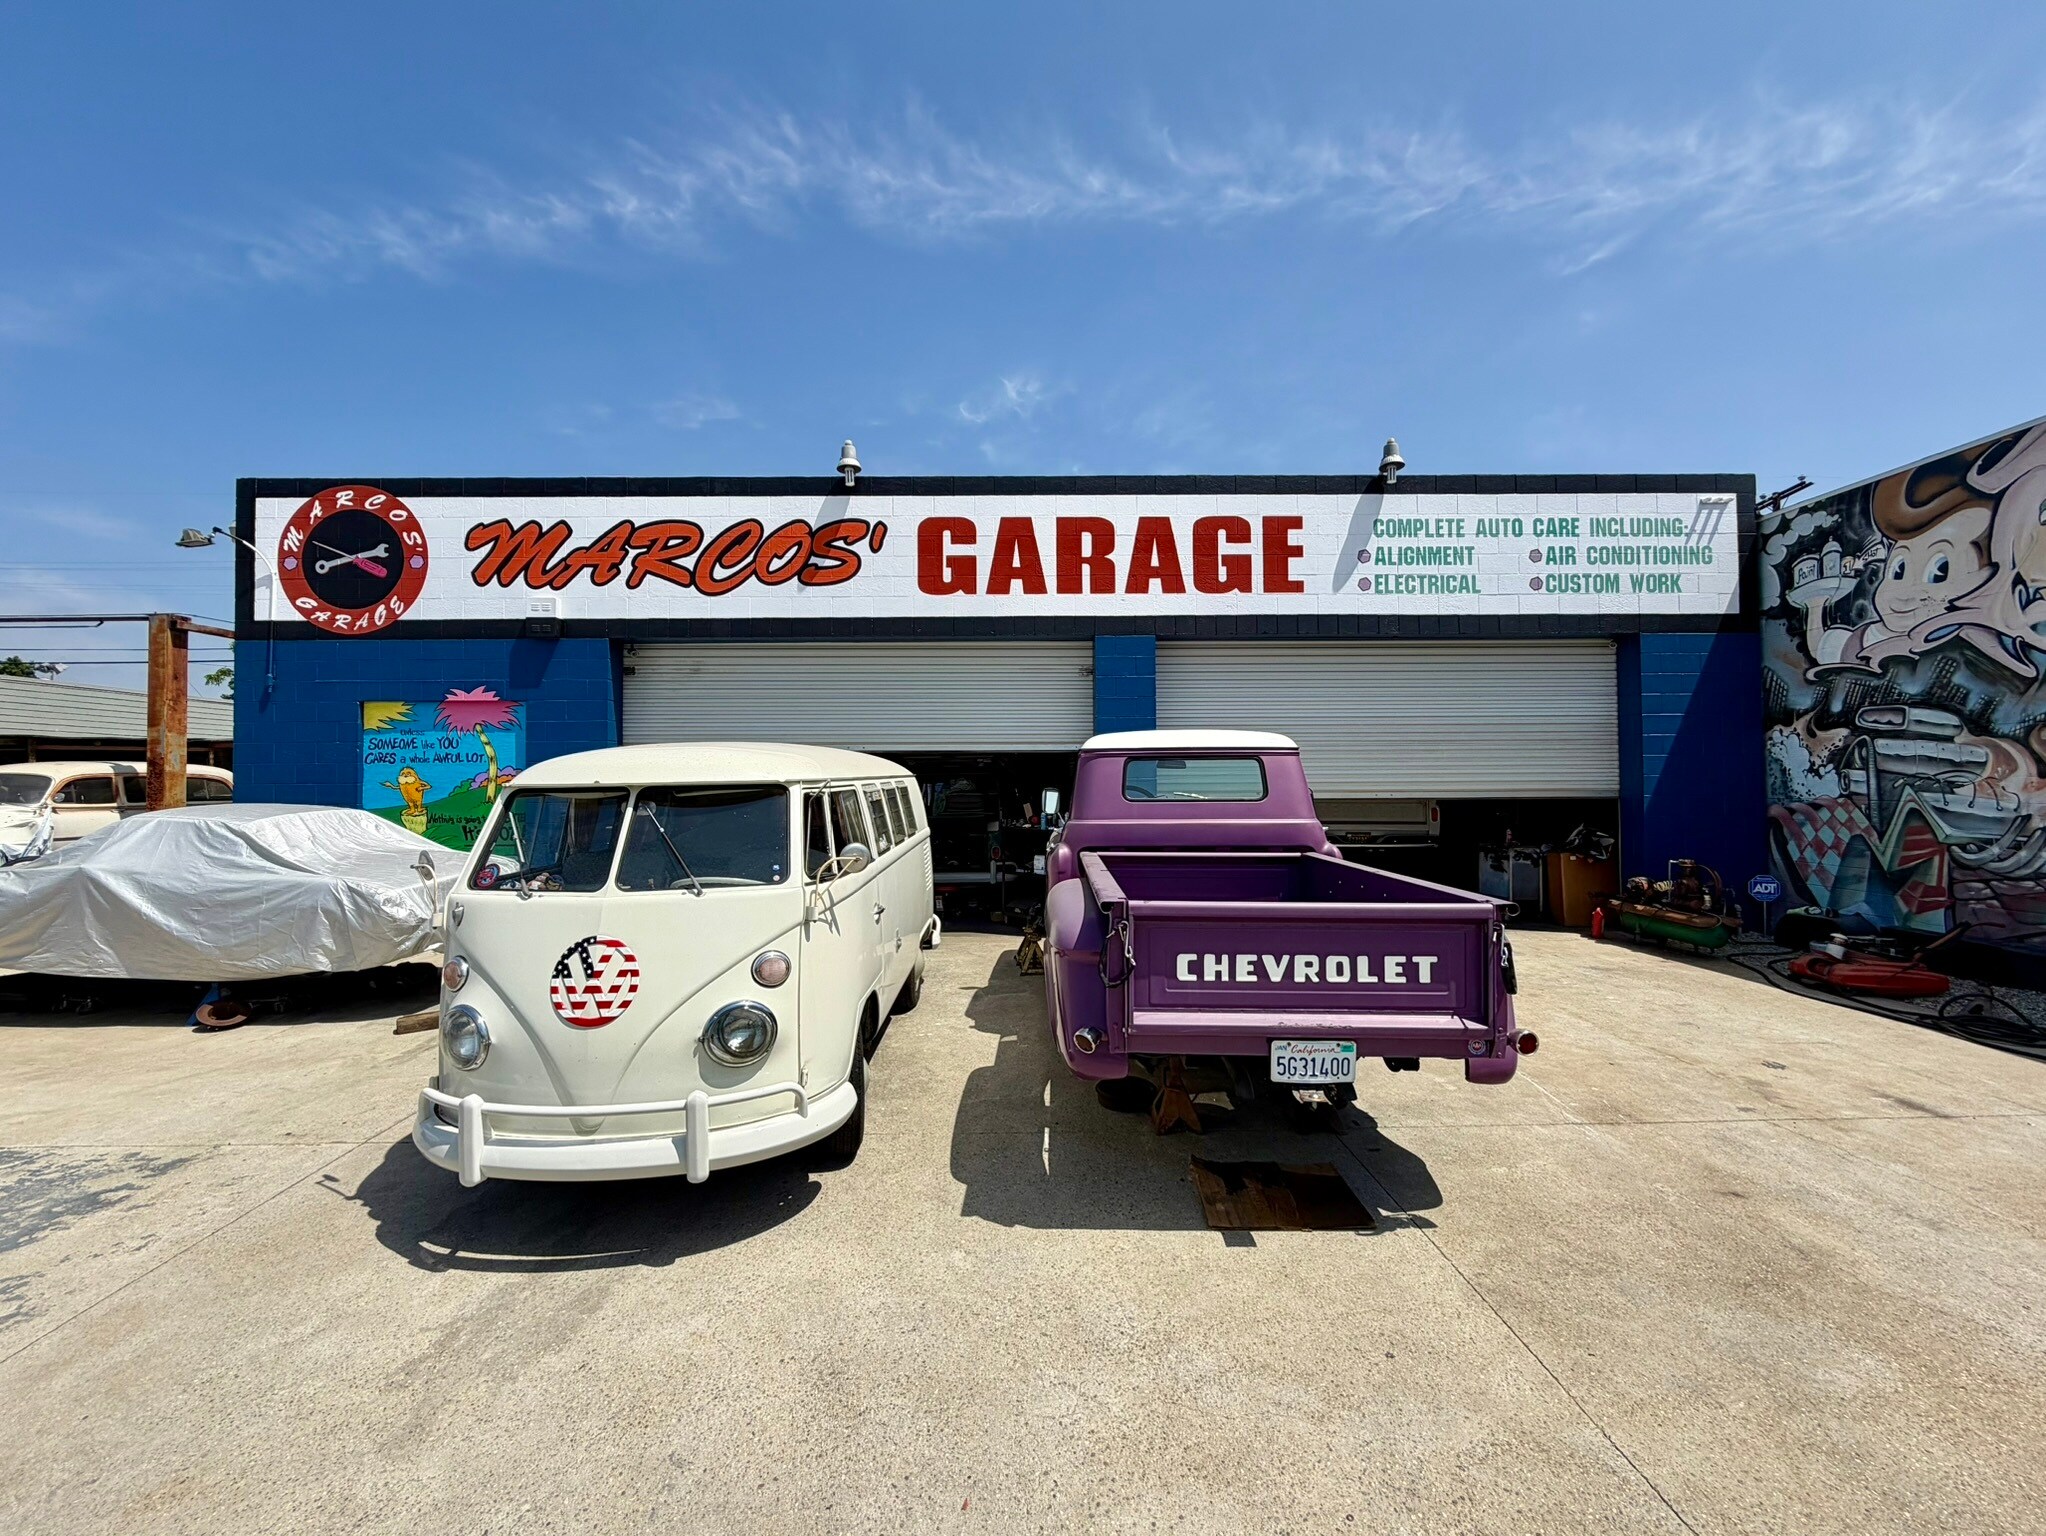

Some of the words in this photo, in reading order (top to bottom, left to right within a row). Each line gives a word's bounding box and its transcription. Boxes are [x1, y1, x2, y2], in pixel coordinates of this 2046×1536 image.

[283, 490, 423, 551] MARCOS'
[1373, 518, 1465, 538] COMPLETE
[1475, 518, 1524, 538] AUTO
[1533, 517, 1580, 537] CARE
[1589, 517, 1689, 537] INCLUDING:
[464, 518, 888, 596] MARCOS'
[917, 515, 1305, 595] GARAGE
[1374, 546, 1475, 566] ALIGNMENT
[1545, 546, 1576, 565] AIR
[1586, 545, 1713, 565] CONDITIONING
[1374, 574, 1481, 594] ELECTRICAL
[1545, 573, 1620, 593] CUSTOM
[1630, 573, 1682, 593] WORK
[295, 595, 404, 631] GARAGE
[368, 737, 418, 750] SOMEONE
[421, 739, 435, 749] like
[436, 736, 459, 749] YOU
[364, 752, 396, 764] CARES
[409, 751, 430, 763] whole
[433, 752, 464, 763] AWFUL
[1753, 883, 1776, 893] ADT
[1176, 954, 1438, 984] CHEVROLET
[1290, 1044, 1339, 1055] California
[1277, 1056, 1350, 1077] 5G31400
